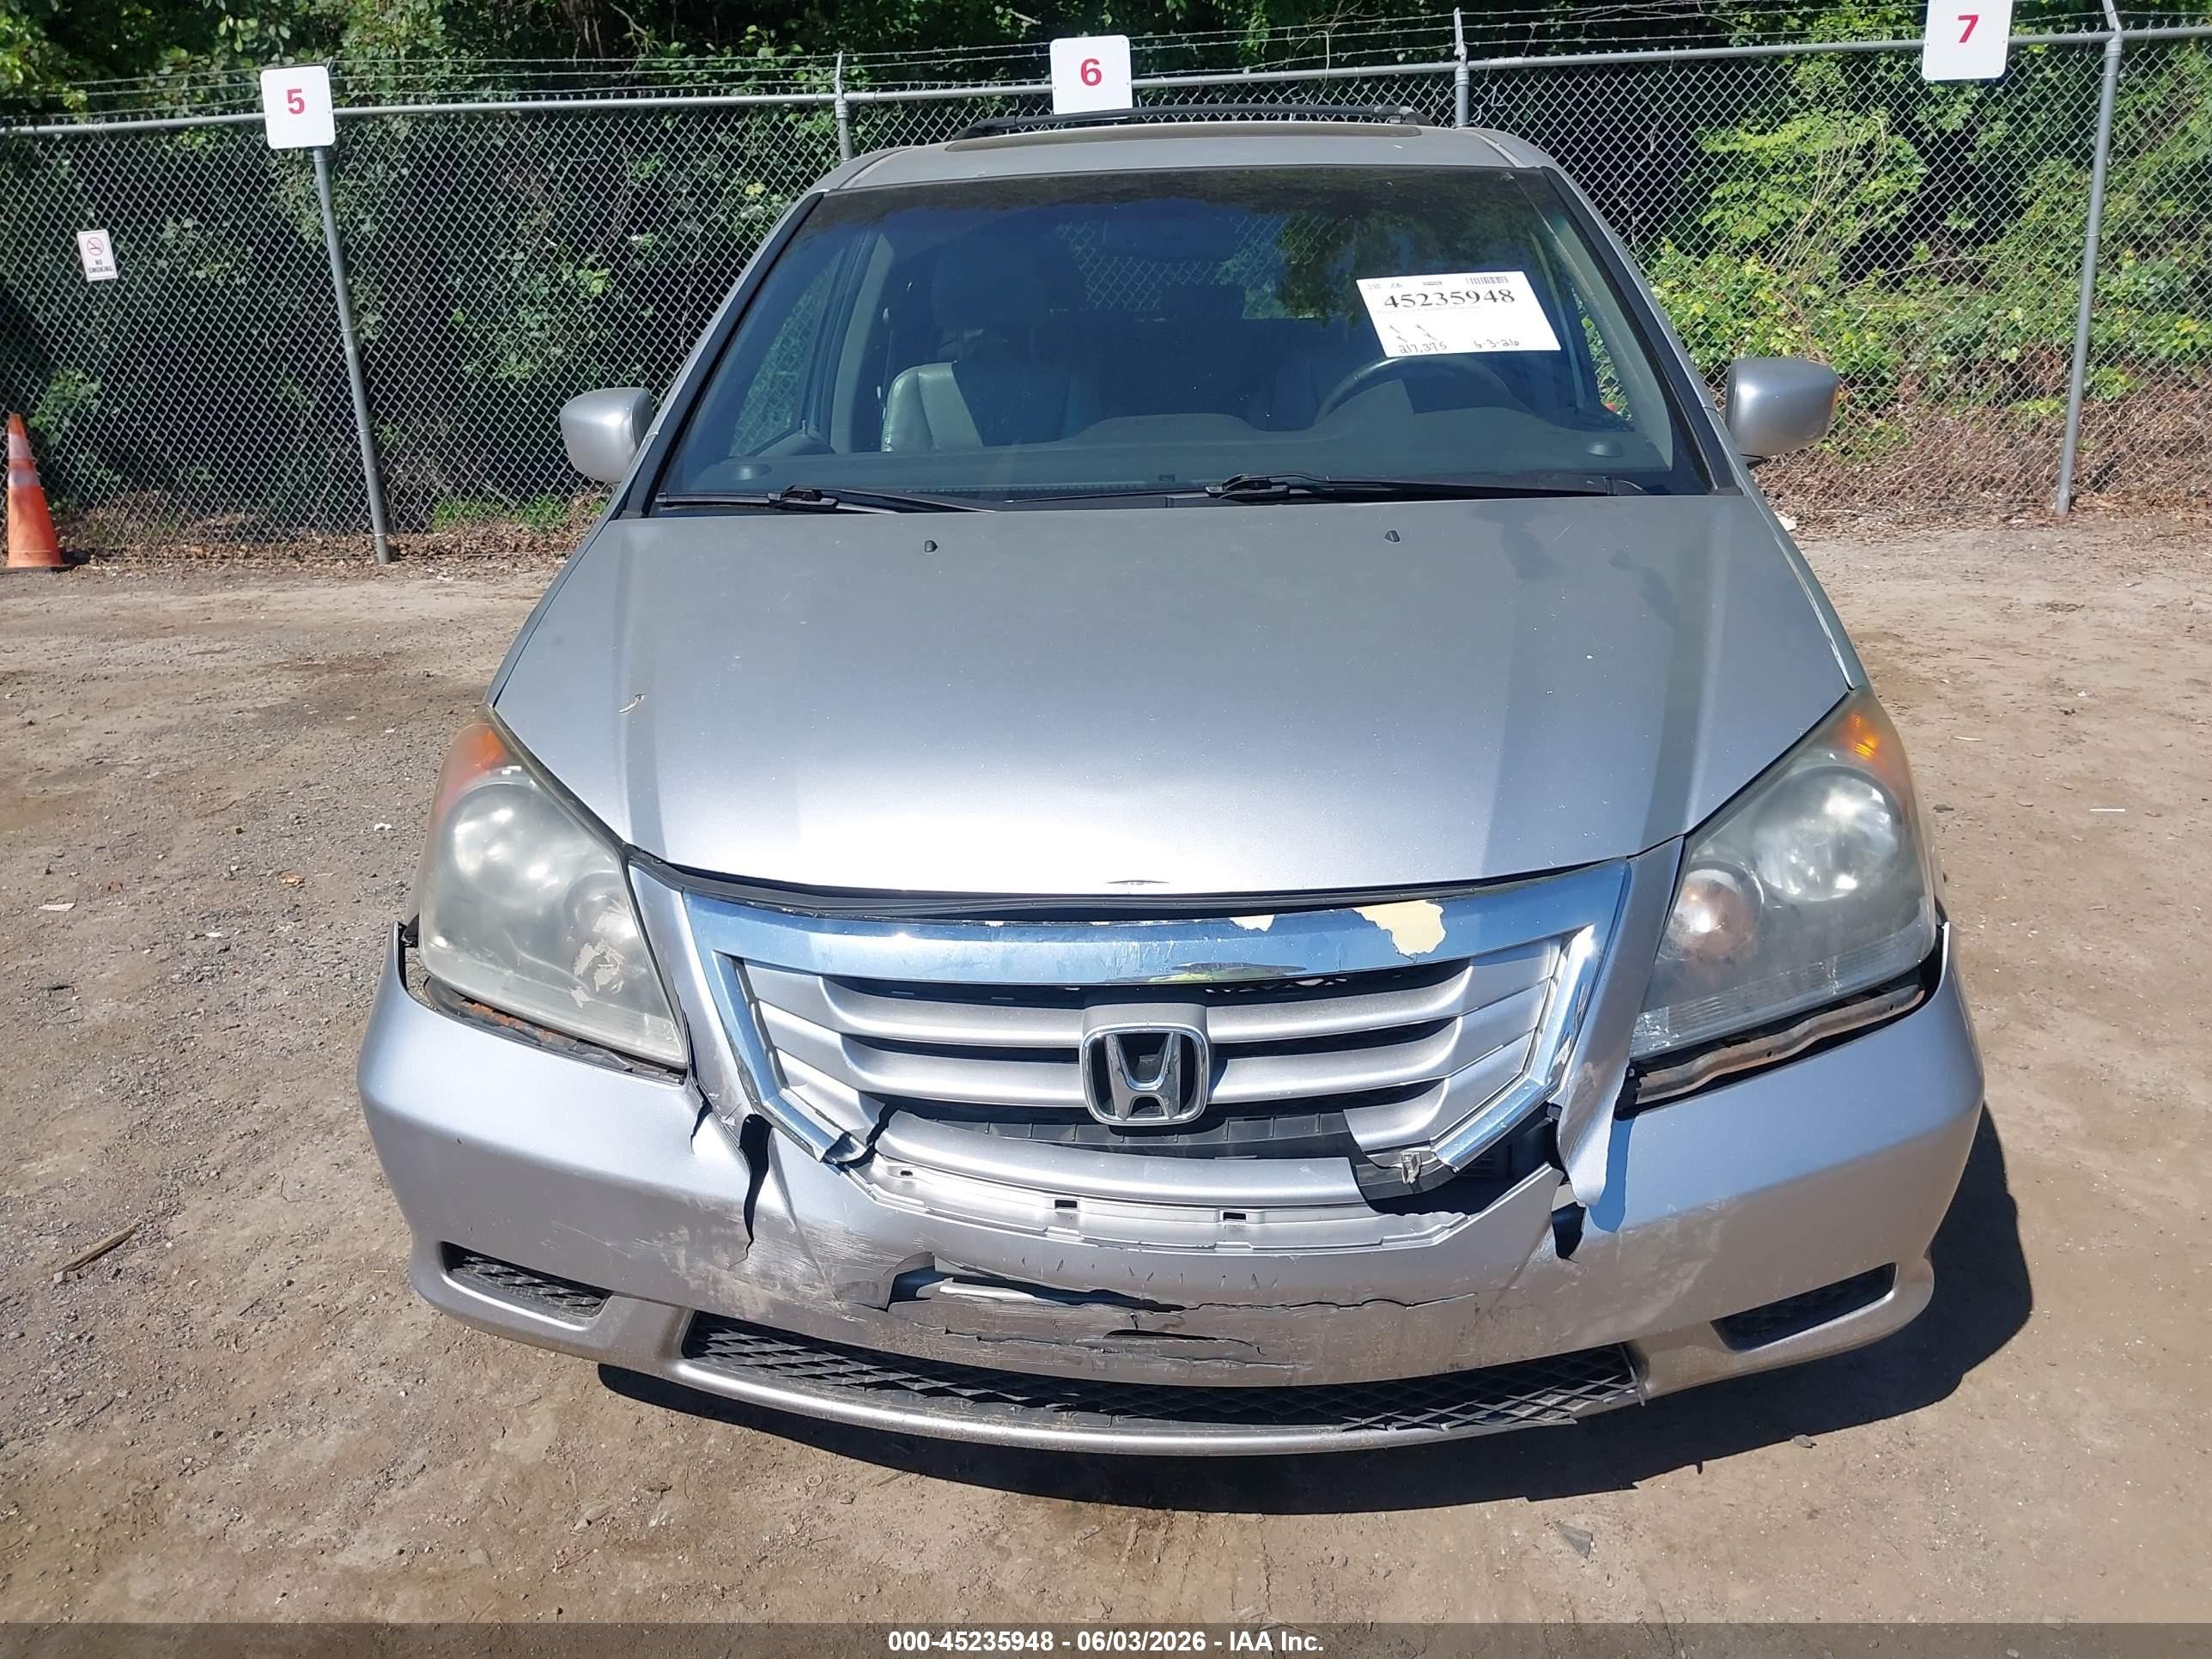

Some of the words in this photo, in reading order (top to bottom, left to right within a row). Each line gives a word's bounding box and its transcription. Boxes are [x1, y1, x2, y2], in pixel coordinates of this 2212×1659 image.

[1958, 15, 1979, 43] 7
[1080, 58, 1102, 86] 6
[287, 88, 305, 114] 5
[1383, 288, 1516, 308] 45235948
